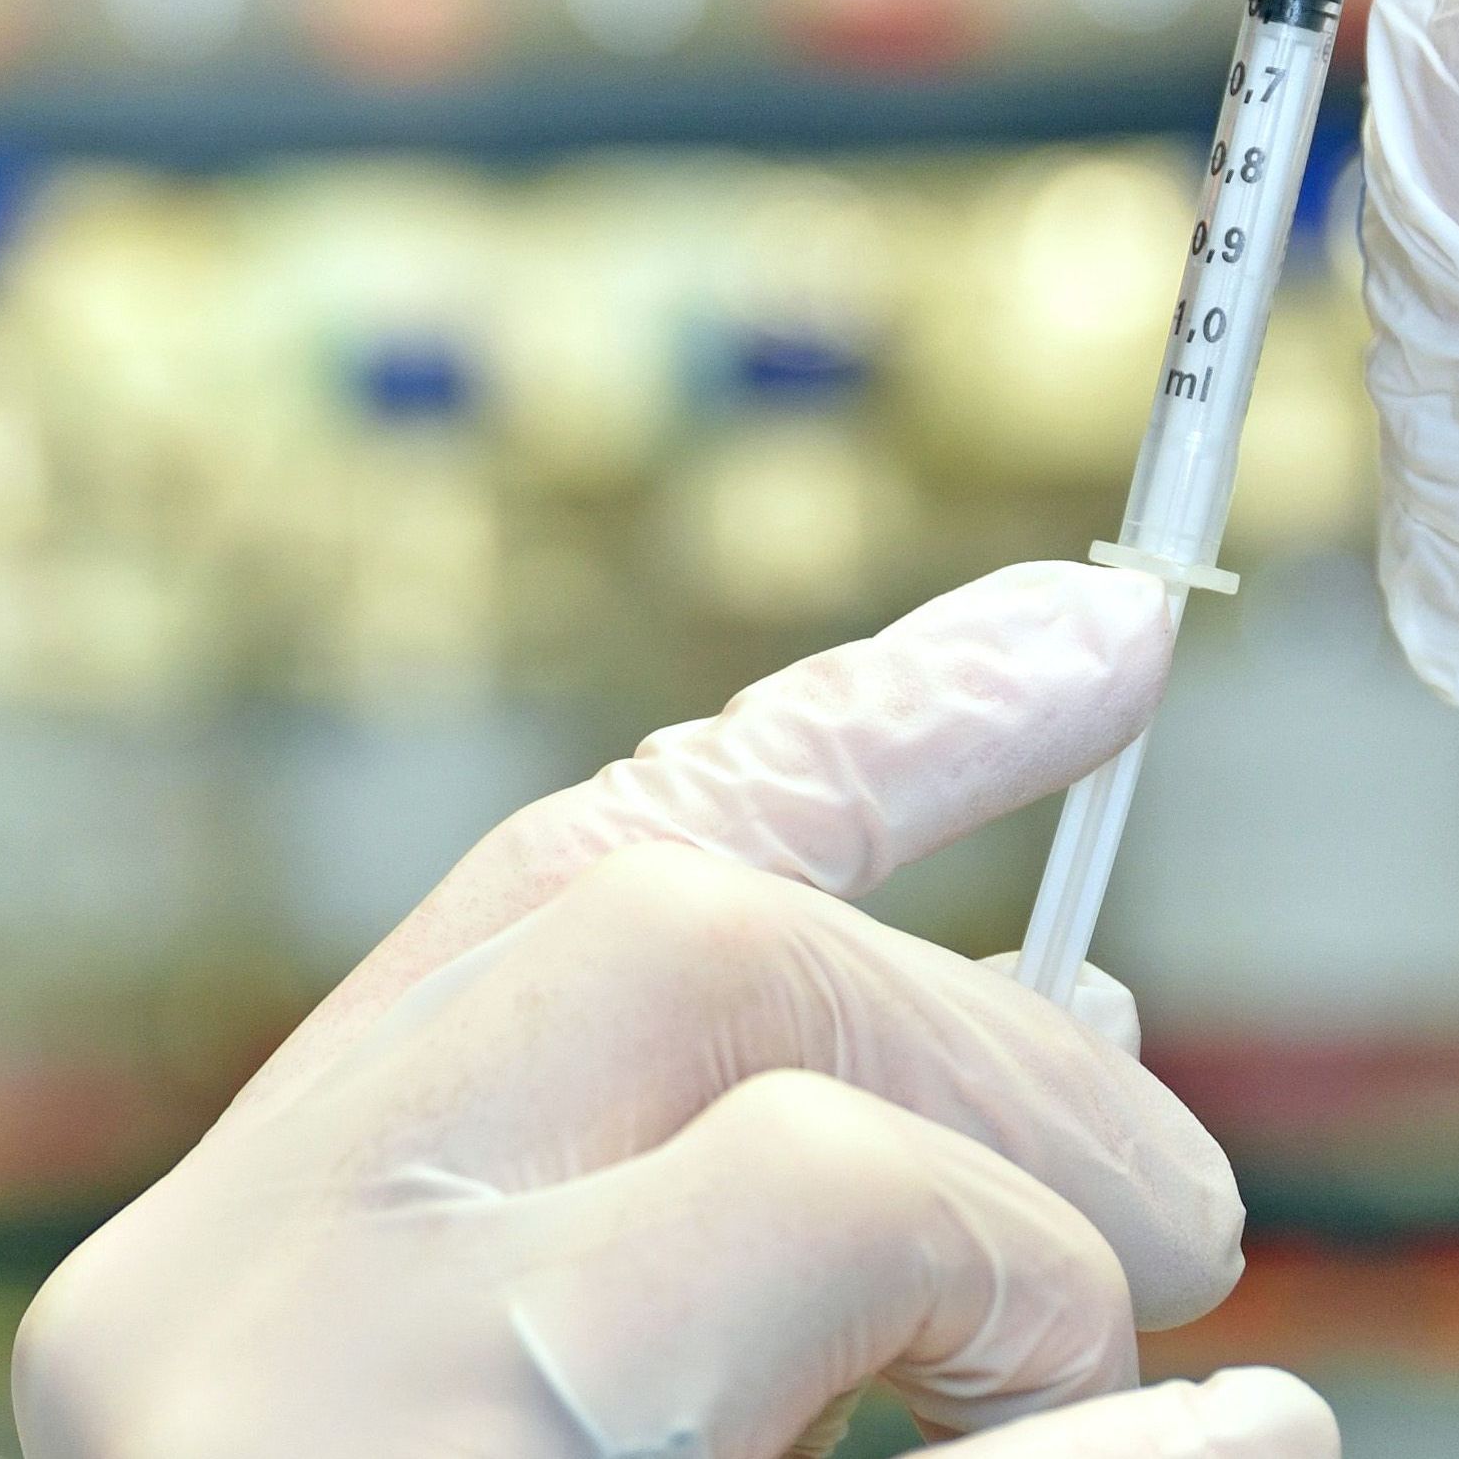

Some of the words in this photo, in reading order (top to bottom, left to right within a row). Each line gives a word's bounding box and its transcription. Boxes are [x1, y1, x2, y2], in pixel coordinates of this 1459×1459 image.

[1229, 60, 1286, 105] 0,7
[1210, 139, 1267, 186] 0,8
[1191, 218, 1247, 267] 0,9
[1173, 298, 1227, 346] 1,0
[1163, 363, 1213, 404] ml
